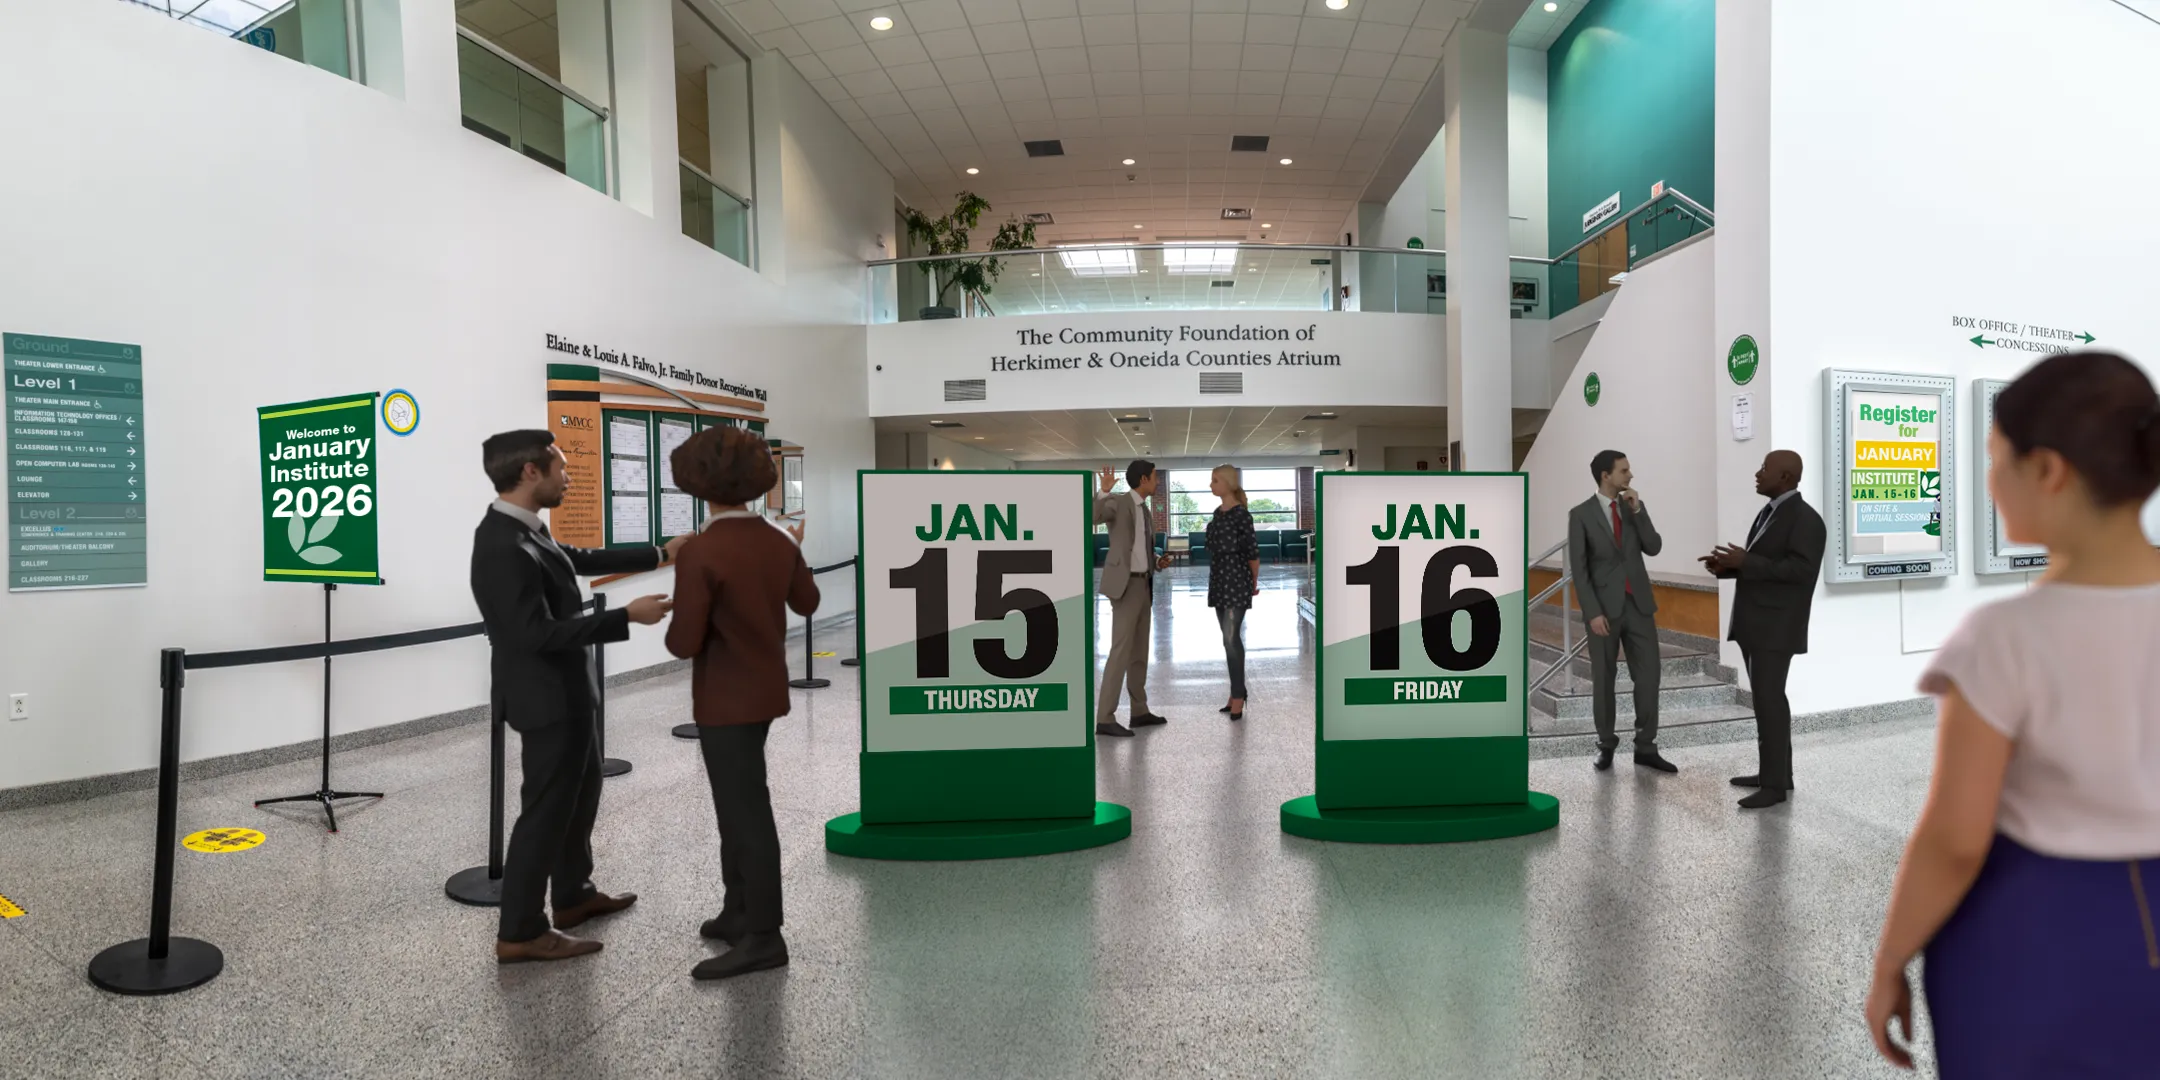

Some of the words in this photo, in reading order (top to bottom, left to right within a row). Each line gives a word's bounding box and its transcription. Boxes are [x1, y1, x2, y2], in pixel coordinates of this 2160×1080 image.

[1017, 328, 1053, 345] The
[1059, 326, 1174, 346] Community
[1179, 325, 1290, 342] Foundation
[1295, 324, 1317, 341] of
[1952, 315, 1976, 329] BOX
[1979, 319, 2018, 334] OFFICE
[2020, 325, 2026, 337] /
[2029, 325, 2075, 341] THEATER
[13, 337, 69, 354] Ground
[1996, 337, 2070, 355] CONCESSIONS
[14, 360, 41, 368] THEATER
[42, 361, 63, 369] LOWER
[65, 363, 95, 372] ENTRANCE
[546, 333, 580, 355] Elaine
[582, 344, 592, 357] &
[594, 345, 619, 364] Louis
[620, 353, 630, 367] A.
[632, 355, 658, 375] Falvo,
[658, 362, 668, 378] Jr.
[669, 365, 694, 385] Family
[696, 372, 718, 388] Donor
[719, 378, 754, 398] Recognition
[754, 388, 767, 401] Wall
[990, 354, 1082, 372] Herkimer
[1087, 352, 1104, 368] &
[1109, 351, 1181, 368] Oneida
[1186, 350, 1272, 366] Counties
[1277, 350, 1342, 366] Atrium
[14, 375, 60, 390] Level
[68, 379, 76, 390] 1
[60, 399, 91, 407] ENTRANCE
[14, 415, 56, 423] CLASSROOMS
[569, 416, 594, 429] MVCC
[1860, 404, 1937, 425] Register
[14, 428, 58, 436] CLASSROOMS
[286, 427, 340, 440] Welcome
[343, 424, 356, 434] to
[1899, 424, 1919, 437] for
[269, 438, 371, 461] January
[1858, 447, 1934, 461] JANUARY
[270, 460, 369, 483] Institute
[1852, 472, 1915, 485] INSTITUTE
[272, 483, 373, 518] 2026
[1852, 489, 1879, 499] JAN.
[1884, 489, 1916, 499] 15-16
[20, 507, 60, 519] Level
[66, 507, 76, 519] 2
[1861, 504, 1872, 512] ON
[1873, 504, 1890, 512] SITE
[1892, 504, 1898, 512] &
[915, 504, 1034, 542] JAN.
[1371, 504, 1480, 540] JAN.
[1861, 513, 1892, 522] VIRTUAL
[1894, 513, 1931, 522] SESSIONS
[1868, 565, 1902, 575] COMING
[1905, 563, 1930, 573] SOON
[2015, 558, 2031, 566] NOW
[889, 547, 1059, 679] 15
[1345, 545, 1502, 671] 16
[1393, 680, 1463, 700] FRIDAY
[924, 688, 1039, 710] THURSDAY
